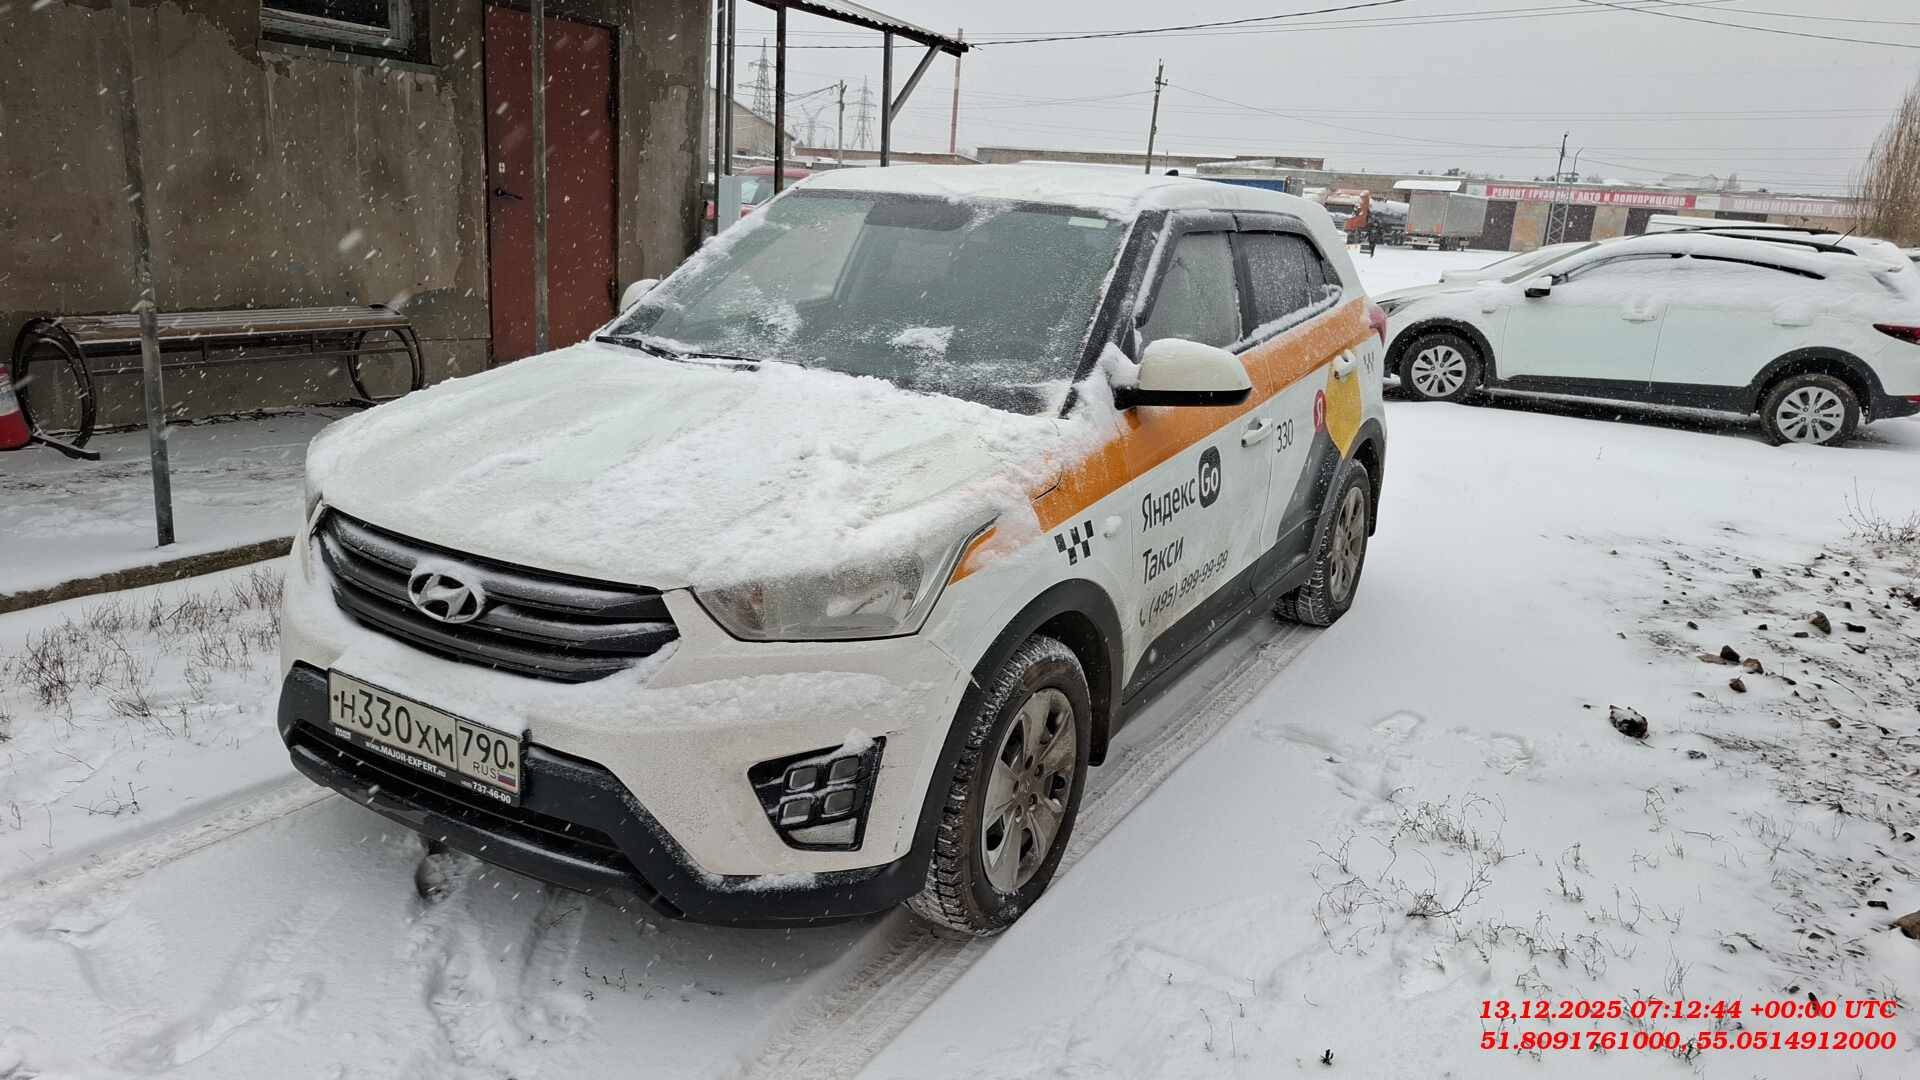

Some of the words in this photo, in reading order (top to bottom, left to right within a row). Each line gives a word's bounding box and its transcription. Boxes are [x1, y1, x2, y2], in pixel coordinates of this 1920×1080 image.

[1492, 187, 1526, 200] РЕМОНТ
[1577, 190, 1600, 202] АВТО
[1603, 192, 1611, 202] И
[1276, 418, 1294, 454] 330
[1141, 477, 1196, 532] Яндекс
[1201, 462, 1219, 497] Go
[1142, 536, 1184, 585] Такси
[1148, 581, 1178, 624] (495)
[1178, 549, 1229, 598] 999-99-99
[340, 689, 454, 763] Н330ХМ
[459, 726, 509, 770] 790
[472, 760, 497, 780] RUS
